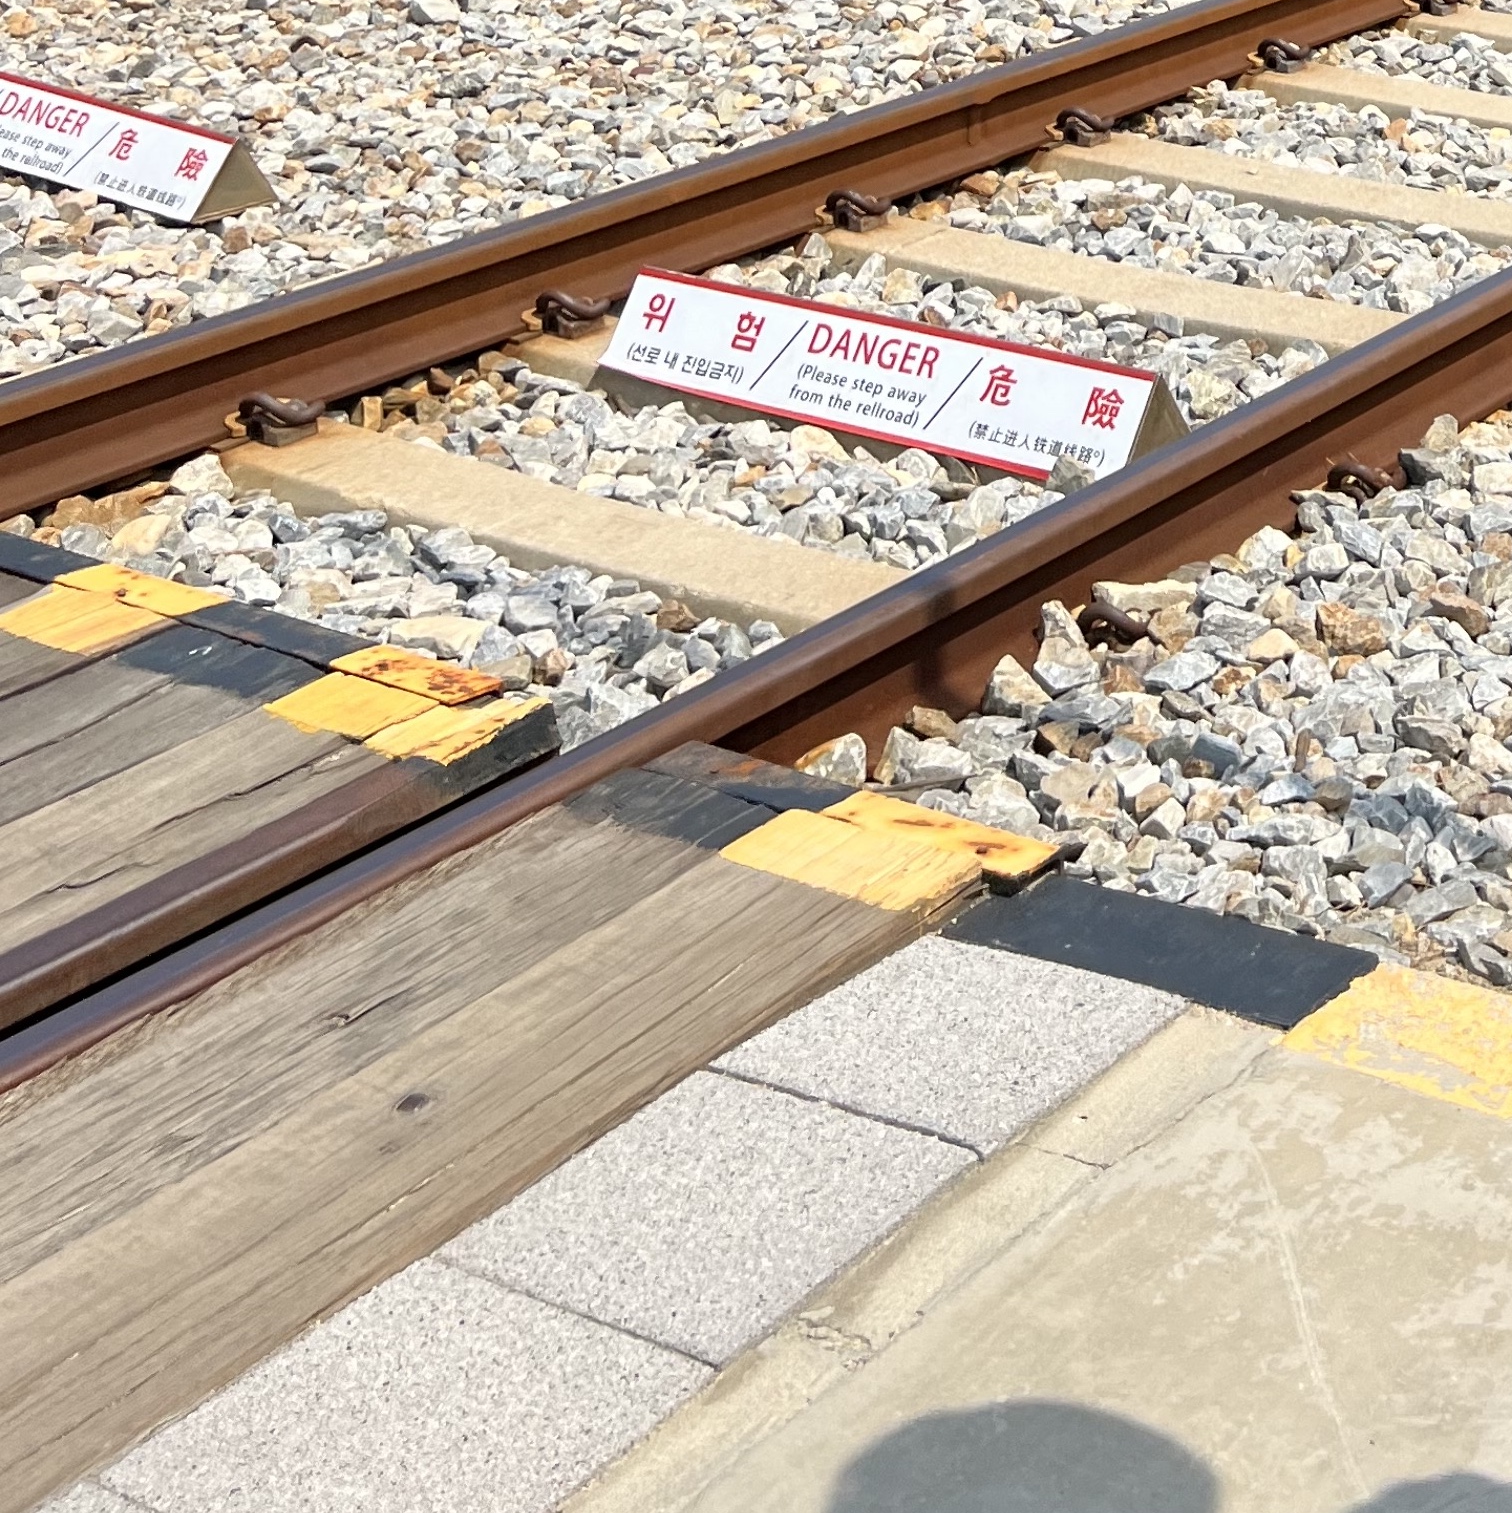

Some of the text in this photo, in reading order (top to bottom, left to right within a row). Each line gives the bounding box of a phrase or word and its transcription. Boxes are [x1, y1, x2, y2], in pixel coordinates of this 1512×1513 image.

[0, 91, 90, 138] DANGER
[21, 134, 44, 151] step
[45, 142, 72, 160] away
[664, 350, 679, 370] 내
[681, 354, 745, 384] 진입금지)
[807, 323, 940, 379] DANGER
[788, 384, 824, 405] from
[828, 393, 852, 411] the
[797, 363, 927, 408] (Please step away
